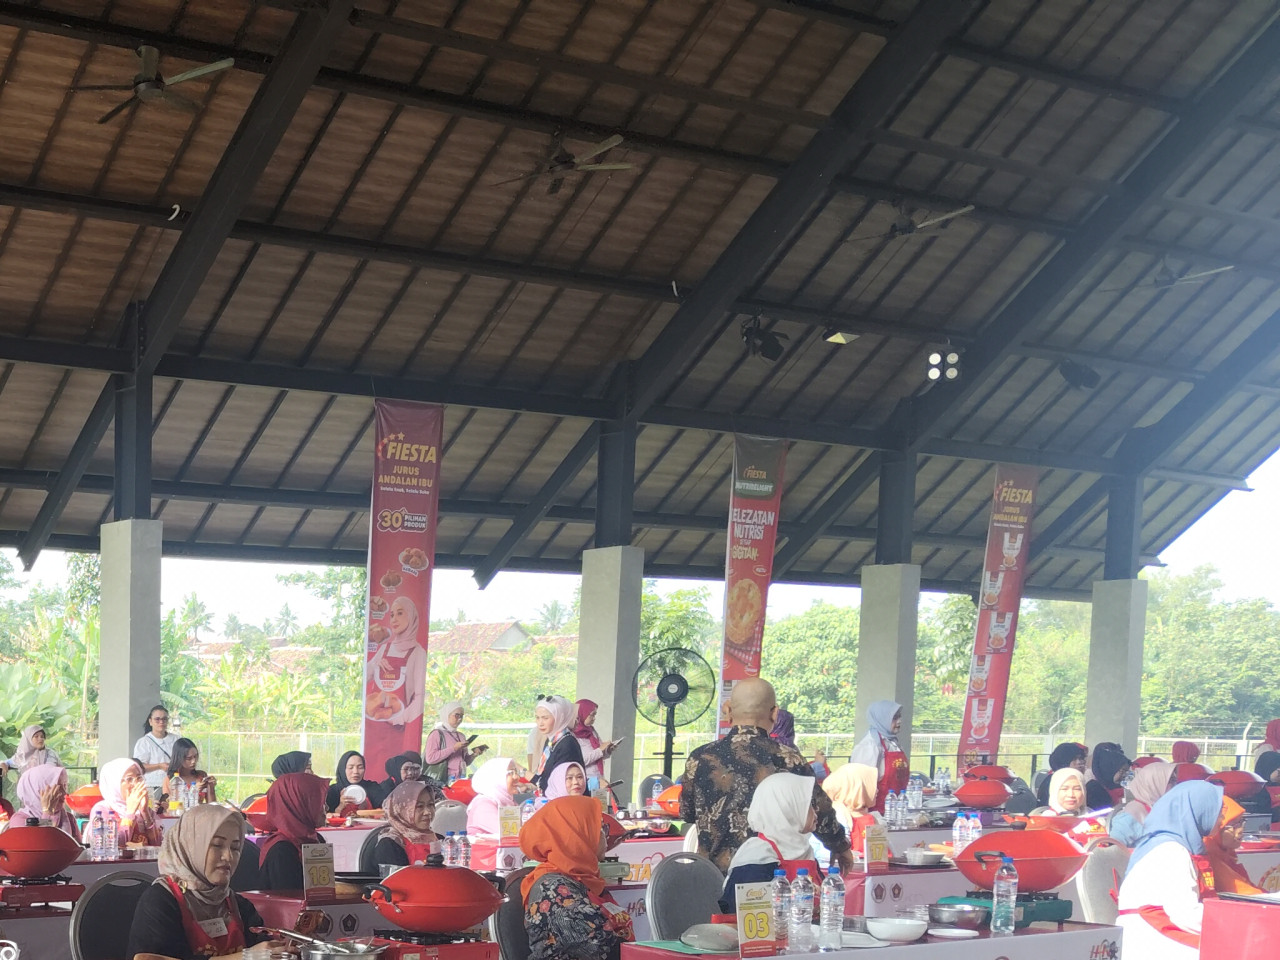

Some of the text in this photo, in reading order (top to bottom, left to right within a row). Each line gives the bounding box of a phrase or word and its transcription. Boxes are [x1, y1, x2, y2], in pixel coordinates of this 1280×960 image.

[386, 442, 437, 464] FIESTA
[392, 465, 419, 476] JURUS
[747, 469, 767, 479] FIESTA
[378, 475, 433, 487] ANDALAN IBU
[1000, 487, 1033, 504] FIESTA
[381, 511, 402, 528] 30
[404, 514, 427, 522] PILIHAN
[732, 508, 775, 526] ELEZATAN
[501, 822, 518, 835] 24
[870, 844, 884, 860] 17
[309, 866, 331, 886] 18
[743, 912, 769, 939] 03
